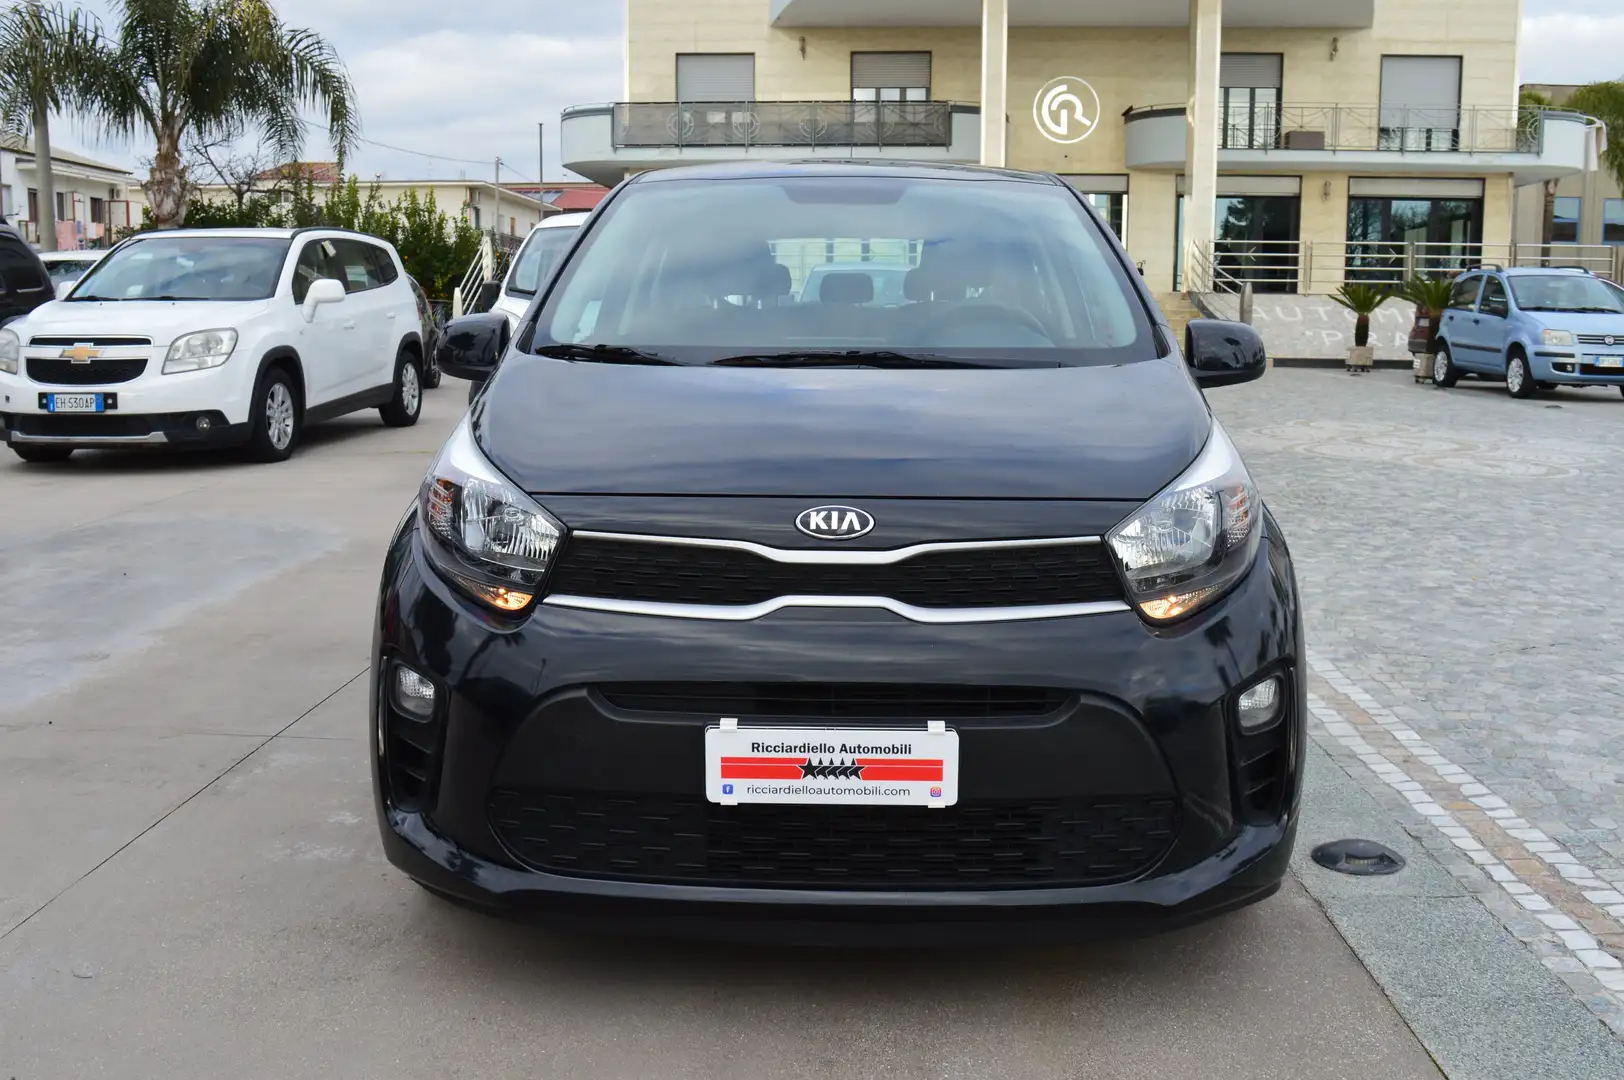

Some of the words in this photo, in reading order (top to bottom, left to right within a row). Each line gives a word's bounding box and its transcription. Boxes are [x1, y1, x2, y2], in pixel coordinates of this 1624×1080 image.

[809, 510, 862, 531] KIA
[751, 742, 835, 754] Ricciardiello
[839, 743, 912, 755] Automobili
[746, 784, 911, 796] ricciardielloautomobili.com
